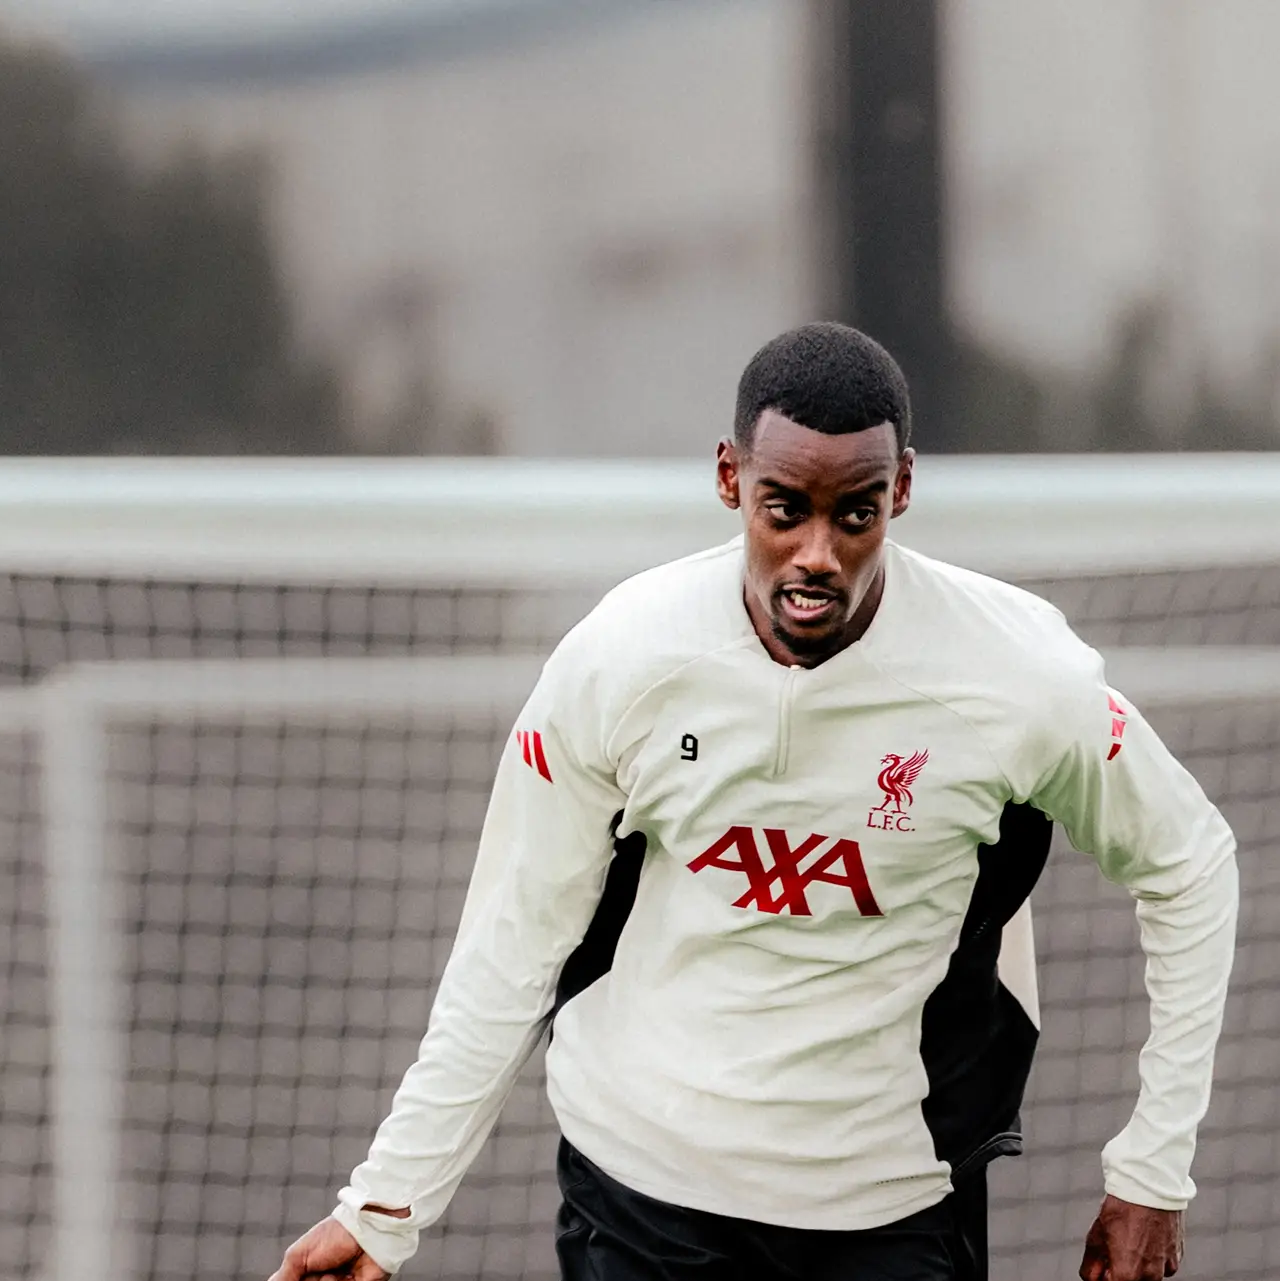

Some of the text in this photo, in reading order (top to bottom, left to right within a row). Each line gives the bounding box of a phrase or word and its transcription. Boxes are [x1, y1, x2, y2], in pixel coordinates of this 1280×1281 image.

[681, 733, 698, 762] 9
[867, 812, 916, 832] L.F.C.
[687, 825, 885, 917] AXA
